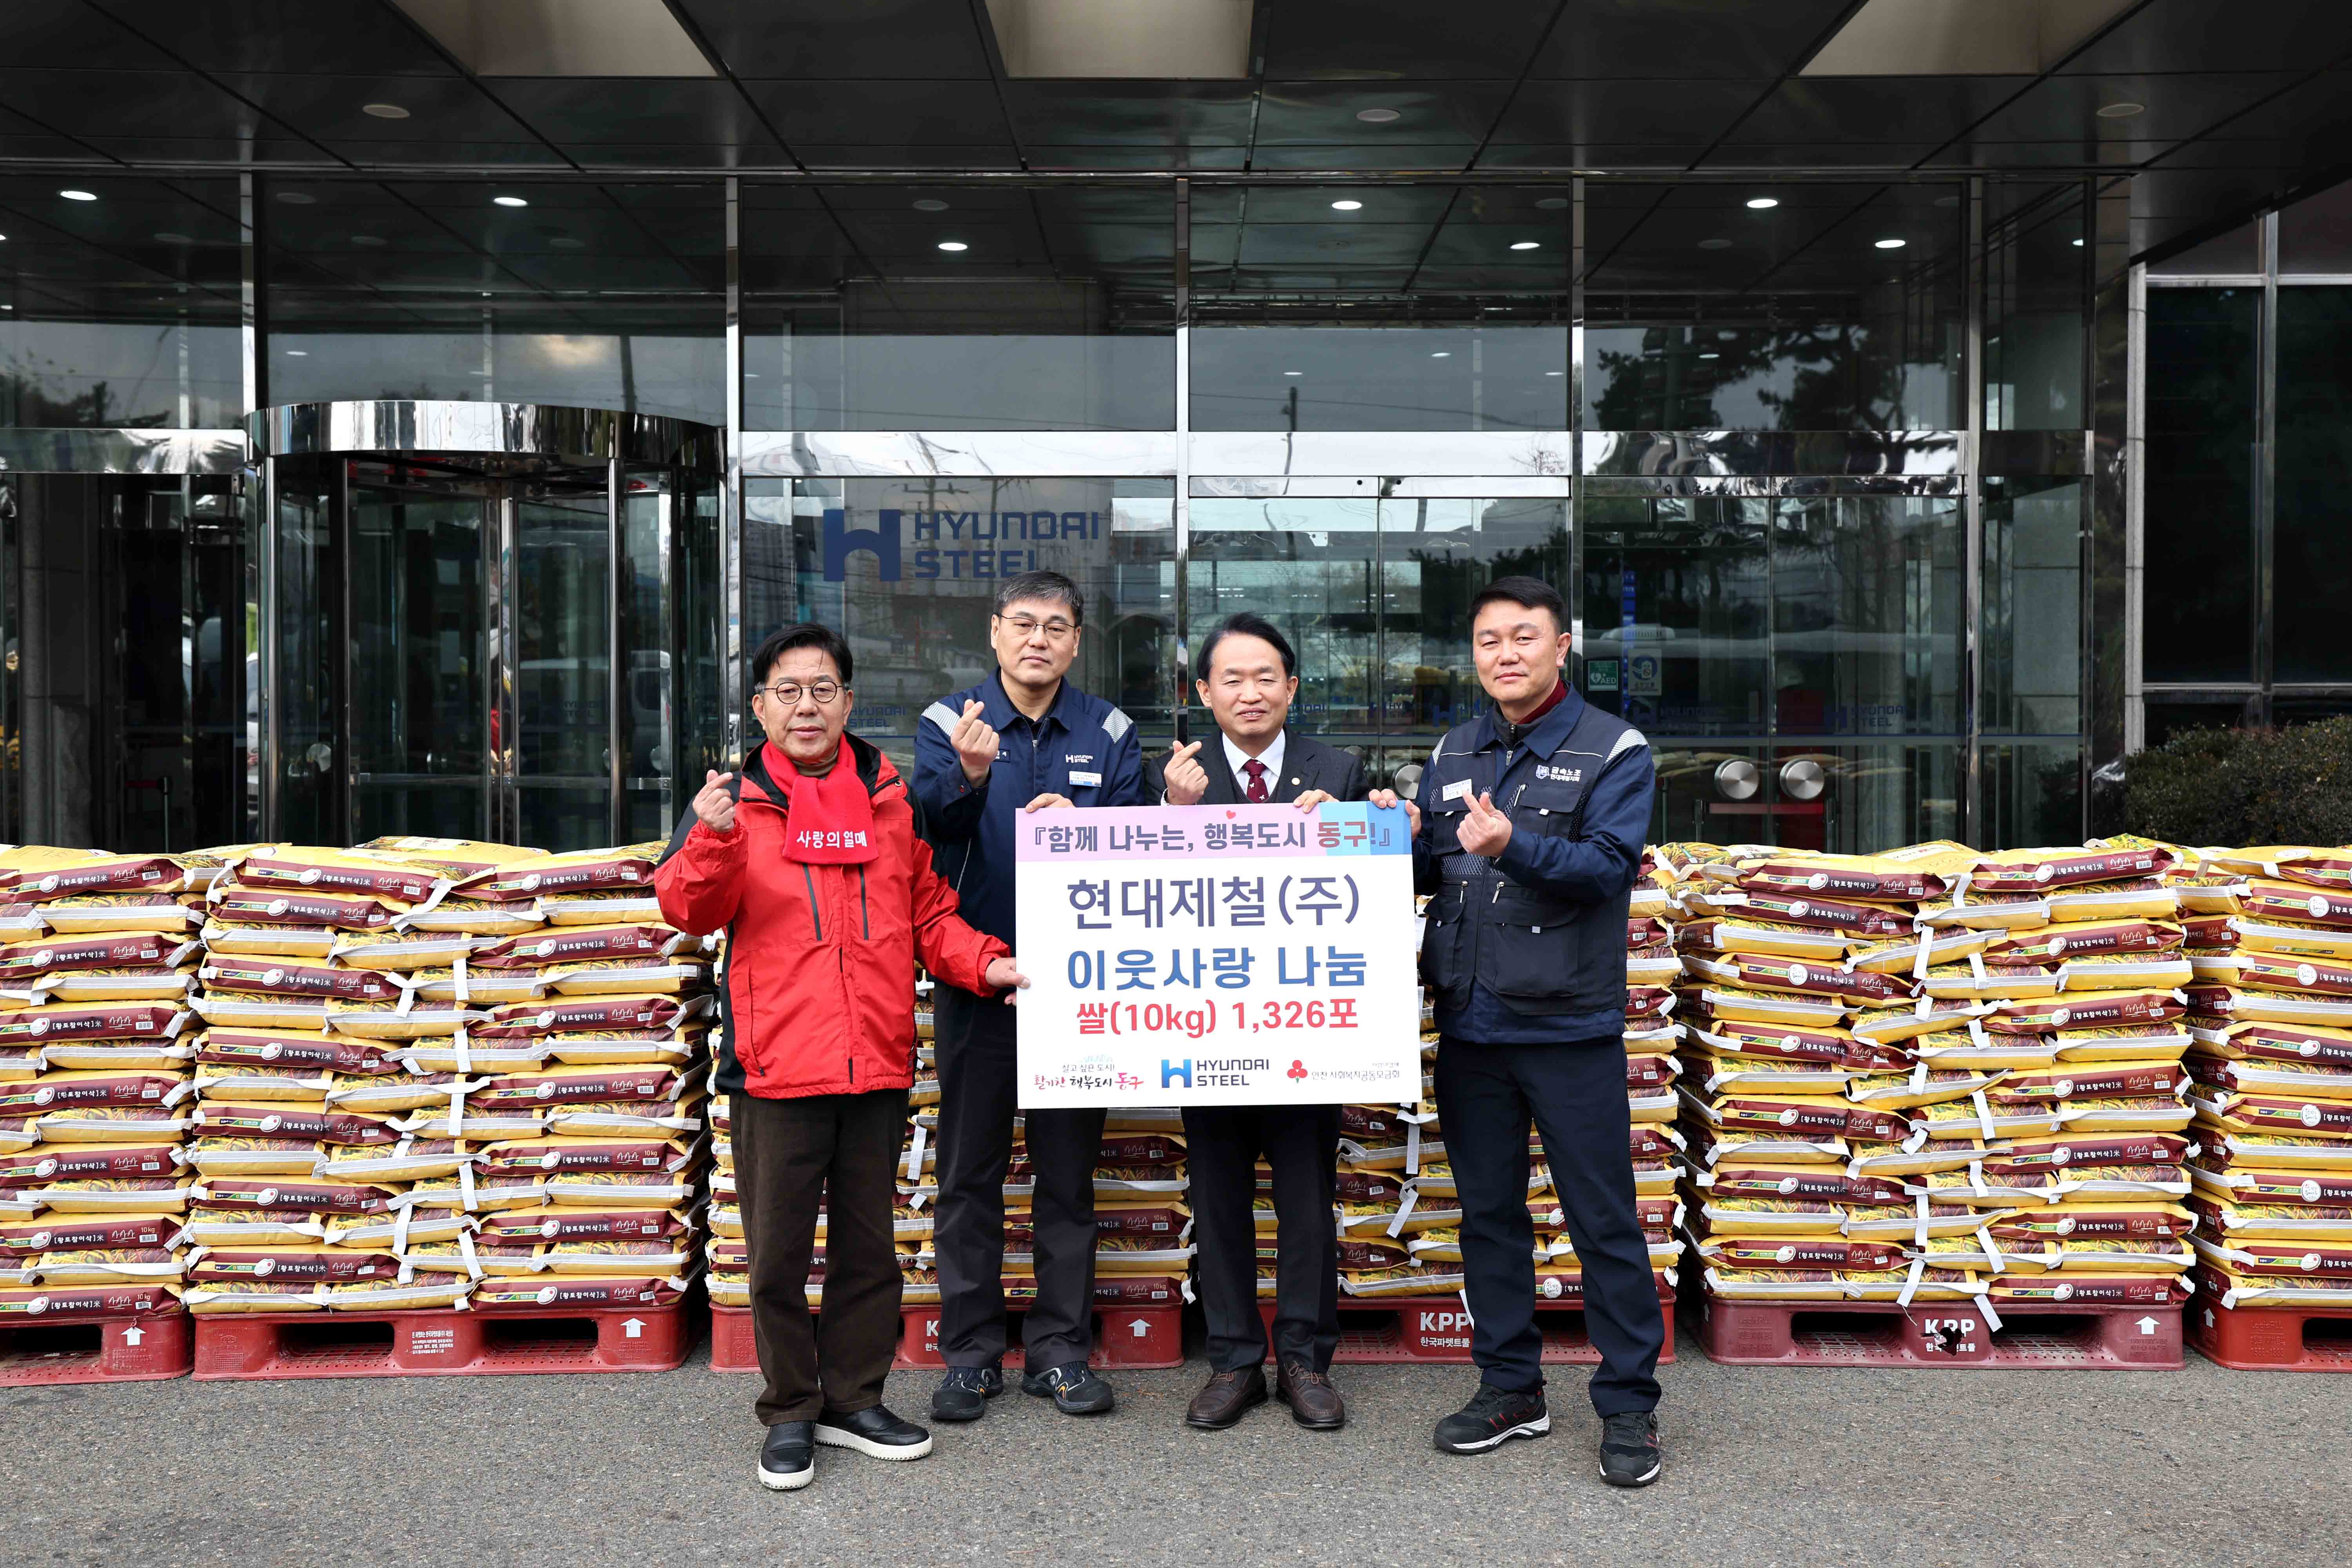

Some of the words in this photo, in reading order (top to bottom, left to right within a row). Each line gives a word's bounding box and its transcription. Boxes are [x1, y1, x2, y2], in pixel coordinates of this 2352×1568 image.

[915, 512, 1098, 540] HYUNDAI
[797, 831, 840, 848] 사랑의
[843, 830, 867, 848] 열매
[1110, 823, 1194, 851] 나누는,
[1204, 822, 1305, 849] 행복도시
[1067, 874, 1359, 929] 현대제철(주)
[1067, 947, 1255, 991] 이웃사랑
[1279, 946, 1367, 987] 나눔
[1077, 1000, 1216, 1038] 쌀(10kg)
[1232, 998, 1358, 1034] 1,326포
[1196, 1059, 1269, 1071] HYUNDAI
[1070, 1075, 1112, 1090] 행복도시
[1114, 1073, 1144, 1090] 동구
[1197, 1074, 1250, 1086] STEEL
[1312, 1071, 1327, 1080] 인천
[1420, 1312, 1470, 1332] KPP
[1420, 1337, 1470, 1348] 한국파렛트풀
[1926, 1342, 1975, 1352] 한국트풀
